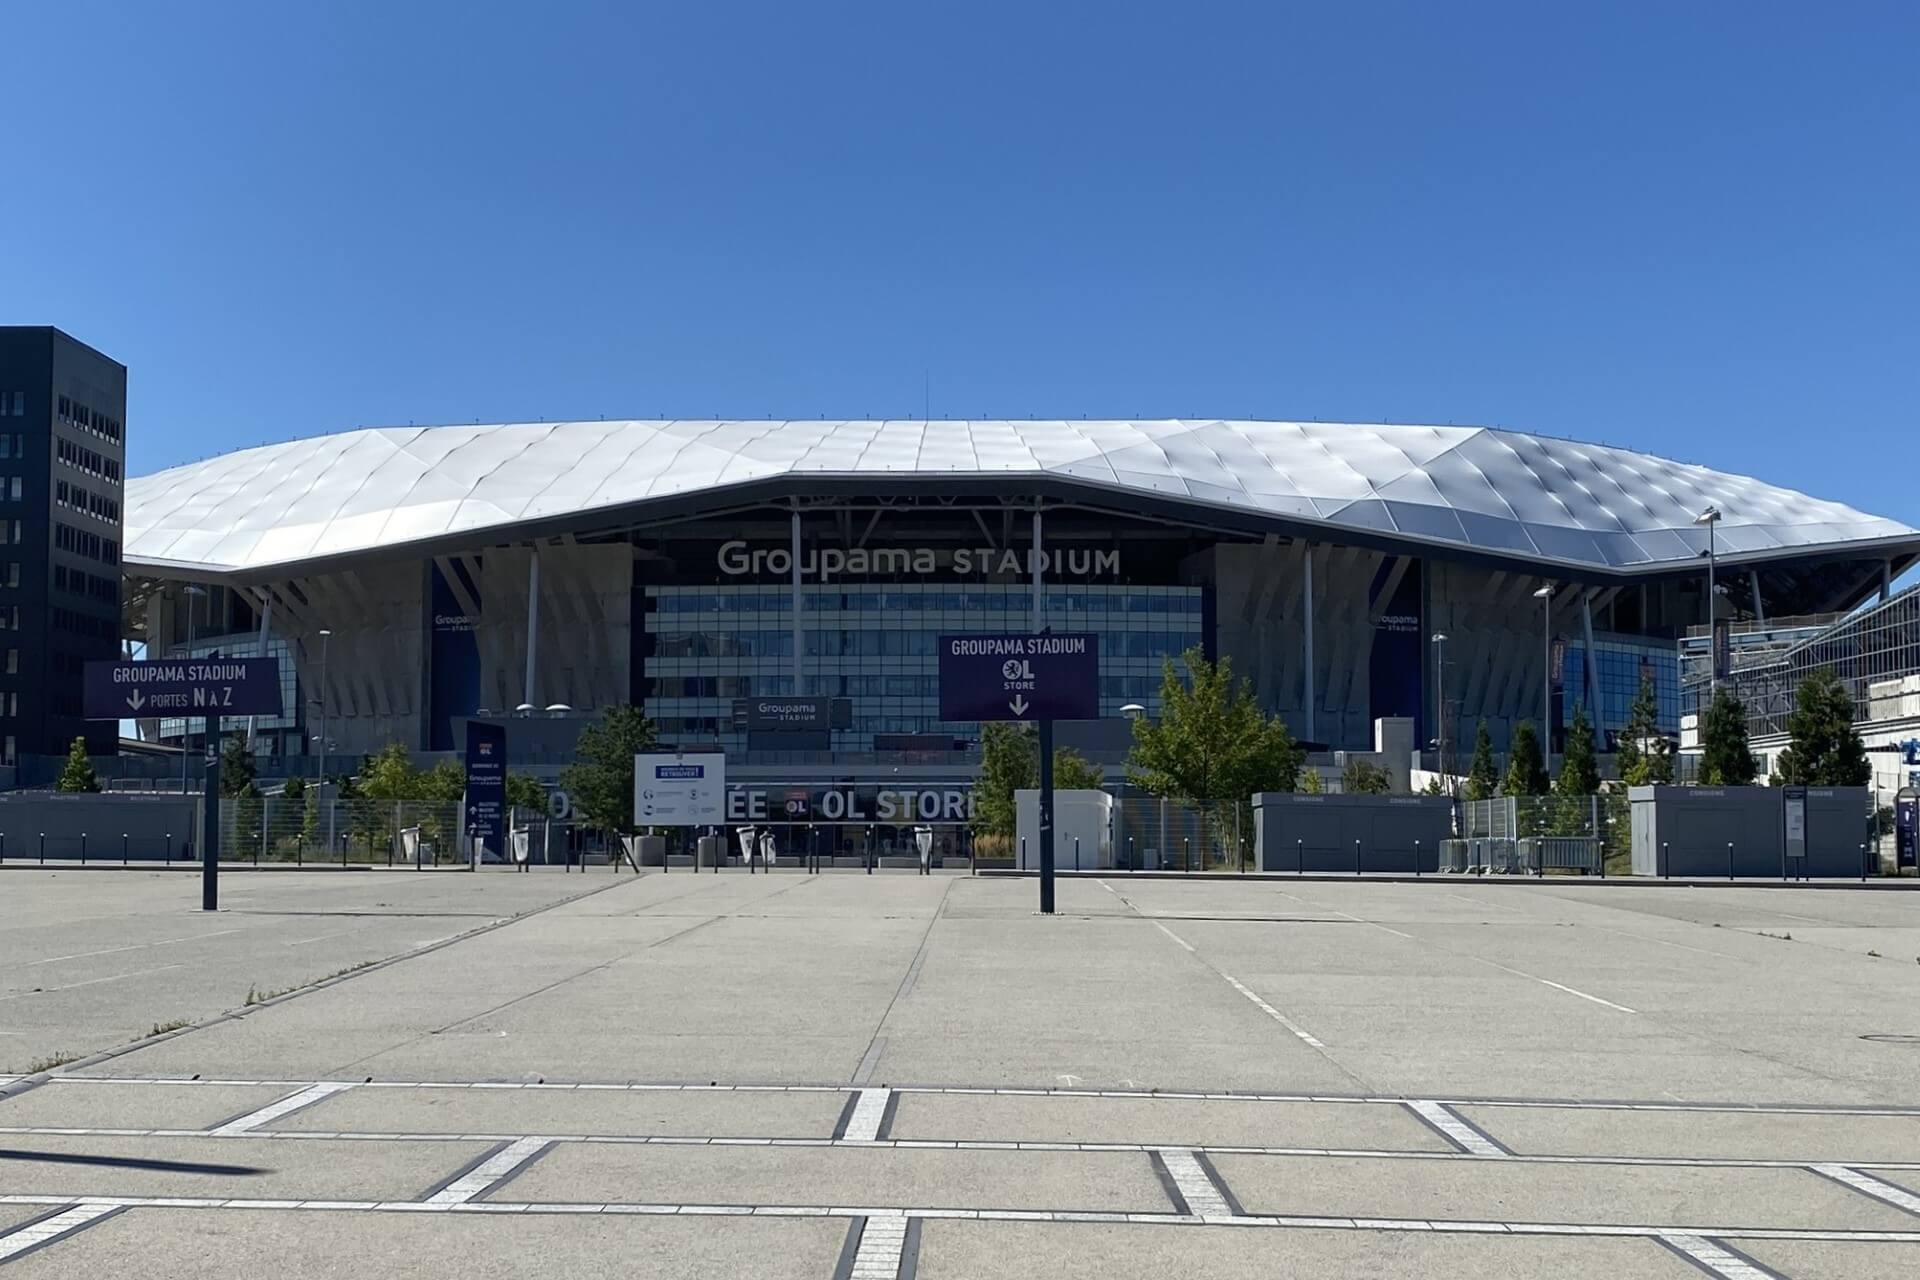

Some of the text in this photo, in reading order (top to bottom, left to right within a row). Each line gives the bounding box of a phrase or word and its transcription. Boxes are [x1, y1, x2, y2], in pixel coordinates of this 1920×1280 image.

[717, 541, 1121, 581] Groupama STADIUM
[951, 638, 1086, 656] GROUPAMA STADIUM
[113, 665, 246, 683] GROUPAMA STADIUM
[1002, 659, 1035, 680] OL
[1003, 681, 1035, 690] STORE
[150, 694, 188, 708] PORTES
[193, 687, 205, 707] N
[223, 687, 233, 706] Z
[758, 703, 816, 714] Groupama
[822, 790, 865, 819] OL
